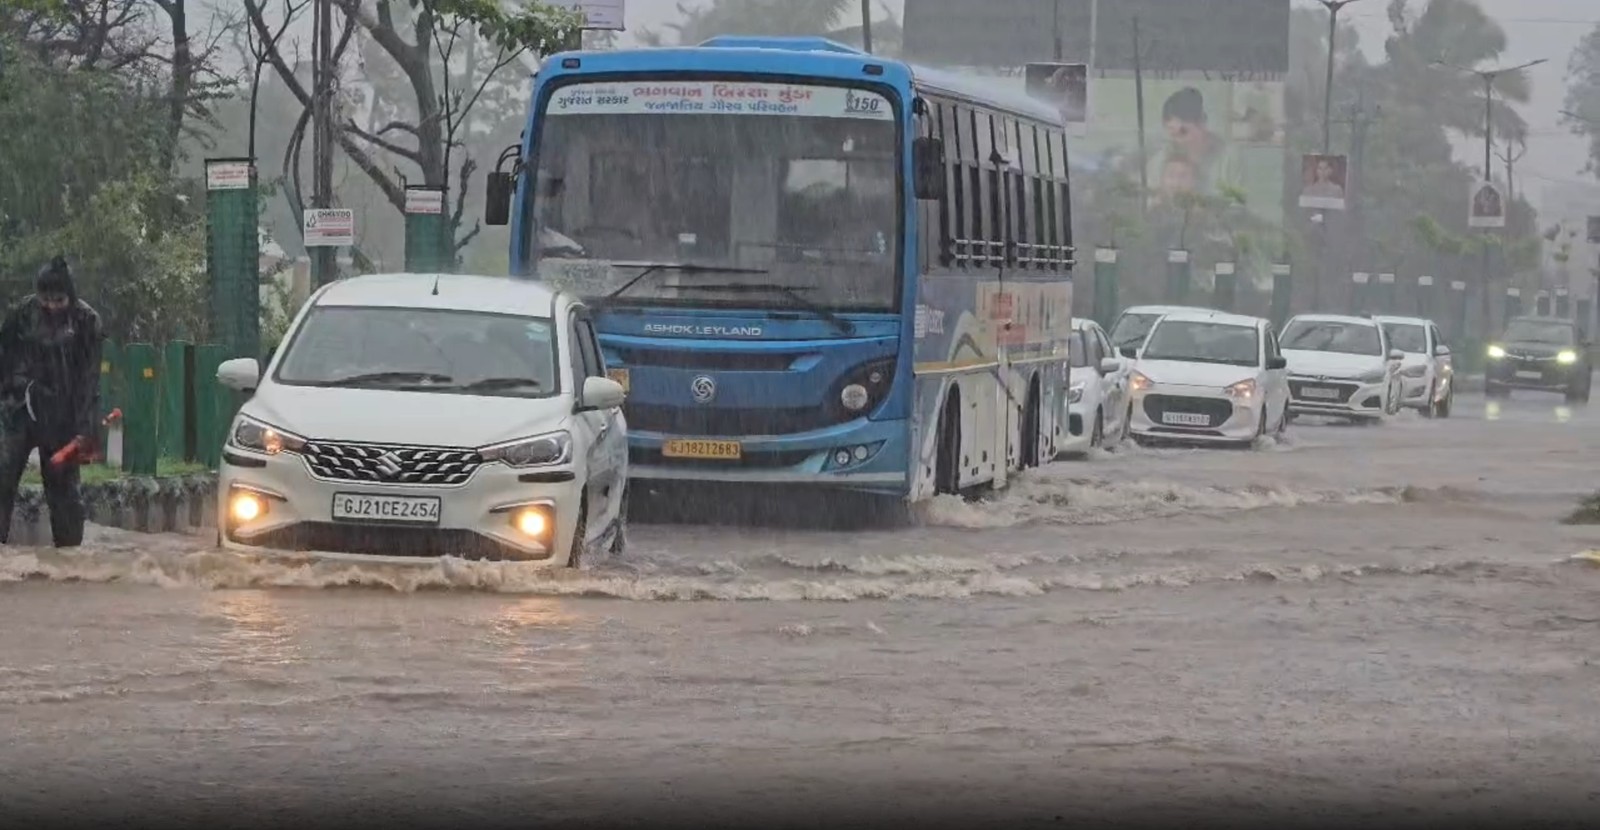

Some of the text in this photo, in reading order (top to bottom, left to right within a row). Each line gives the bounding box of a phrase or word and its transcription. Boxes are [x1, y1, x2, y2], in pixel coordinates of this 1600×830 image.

[558, 95, 629, 109] ગુજરાત સરકાર
[748, 99, 797, 112] પરિવહન
[855, 96, 879, 110] 150
[643, 323, 762, 336] ASHOK LEYLAND
[344, 498, 437, 519] GJ21CE2454
